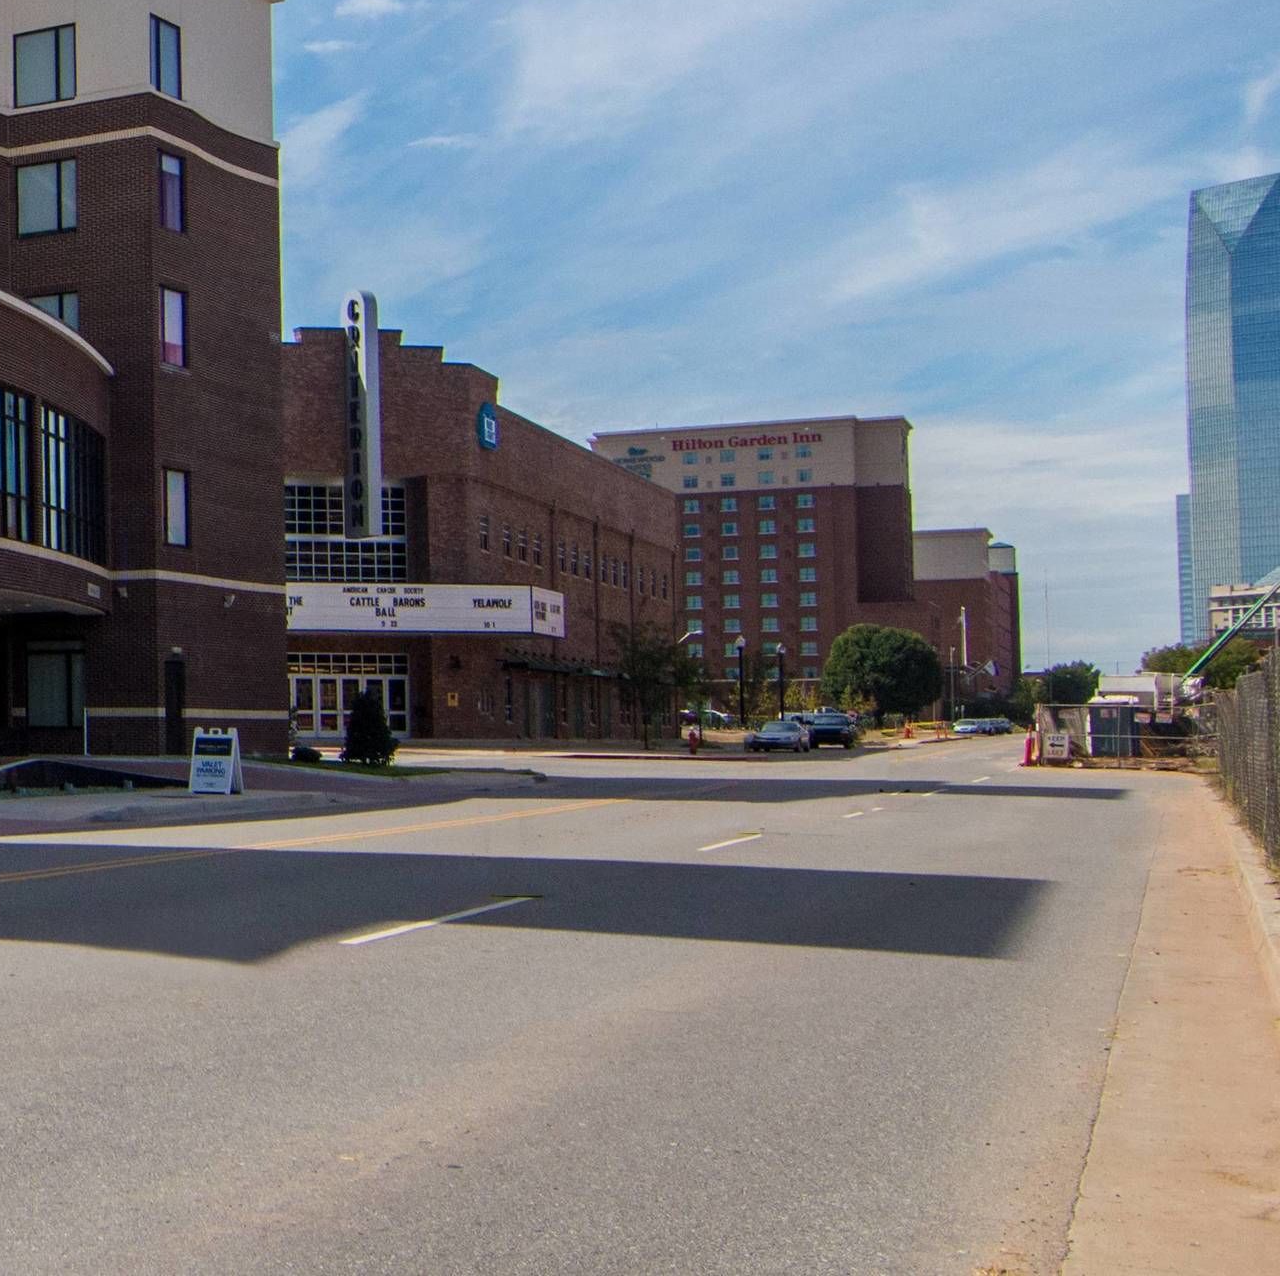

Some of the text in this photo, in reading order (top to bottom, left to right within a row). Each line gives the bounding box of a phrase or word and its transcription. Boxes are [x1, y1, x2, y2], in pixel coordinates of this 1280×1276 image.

[347, 298, 364, 528] CRITERION
[672, 431, 823, 452] Hilton Garden Inn
[288, 596, 303, 606] THE
[349, 596, 426, 607] CATTLE BARONS
[472, 598, 513, 609] YELAWOLF
[375, 607, 396, 617] BALL
